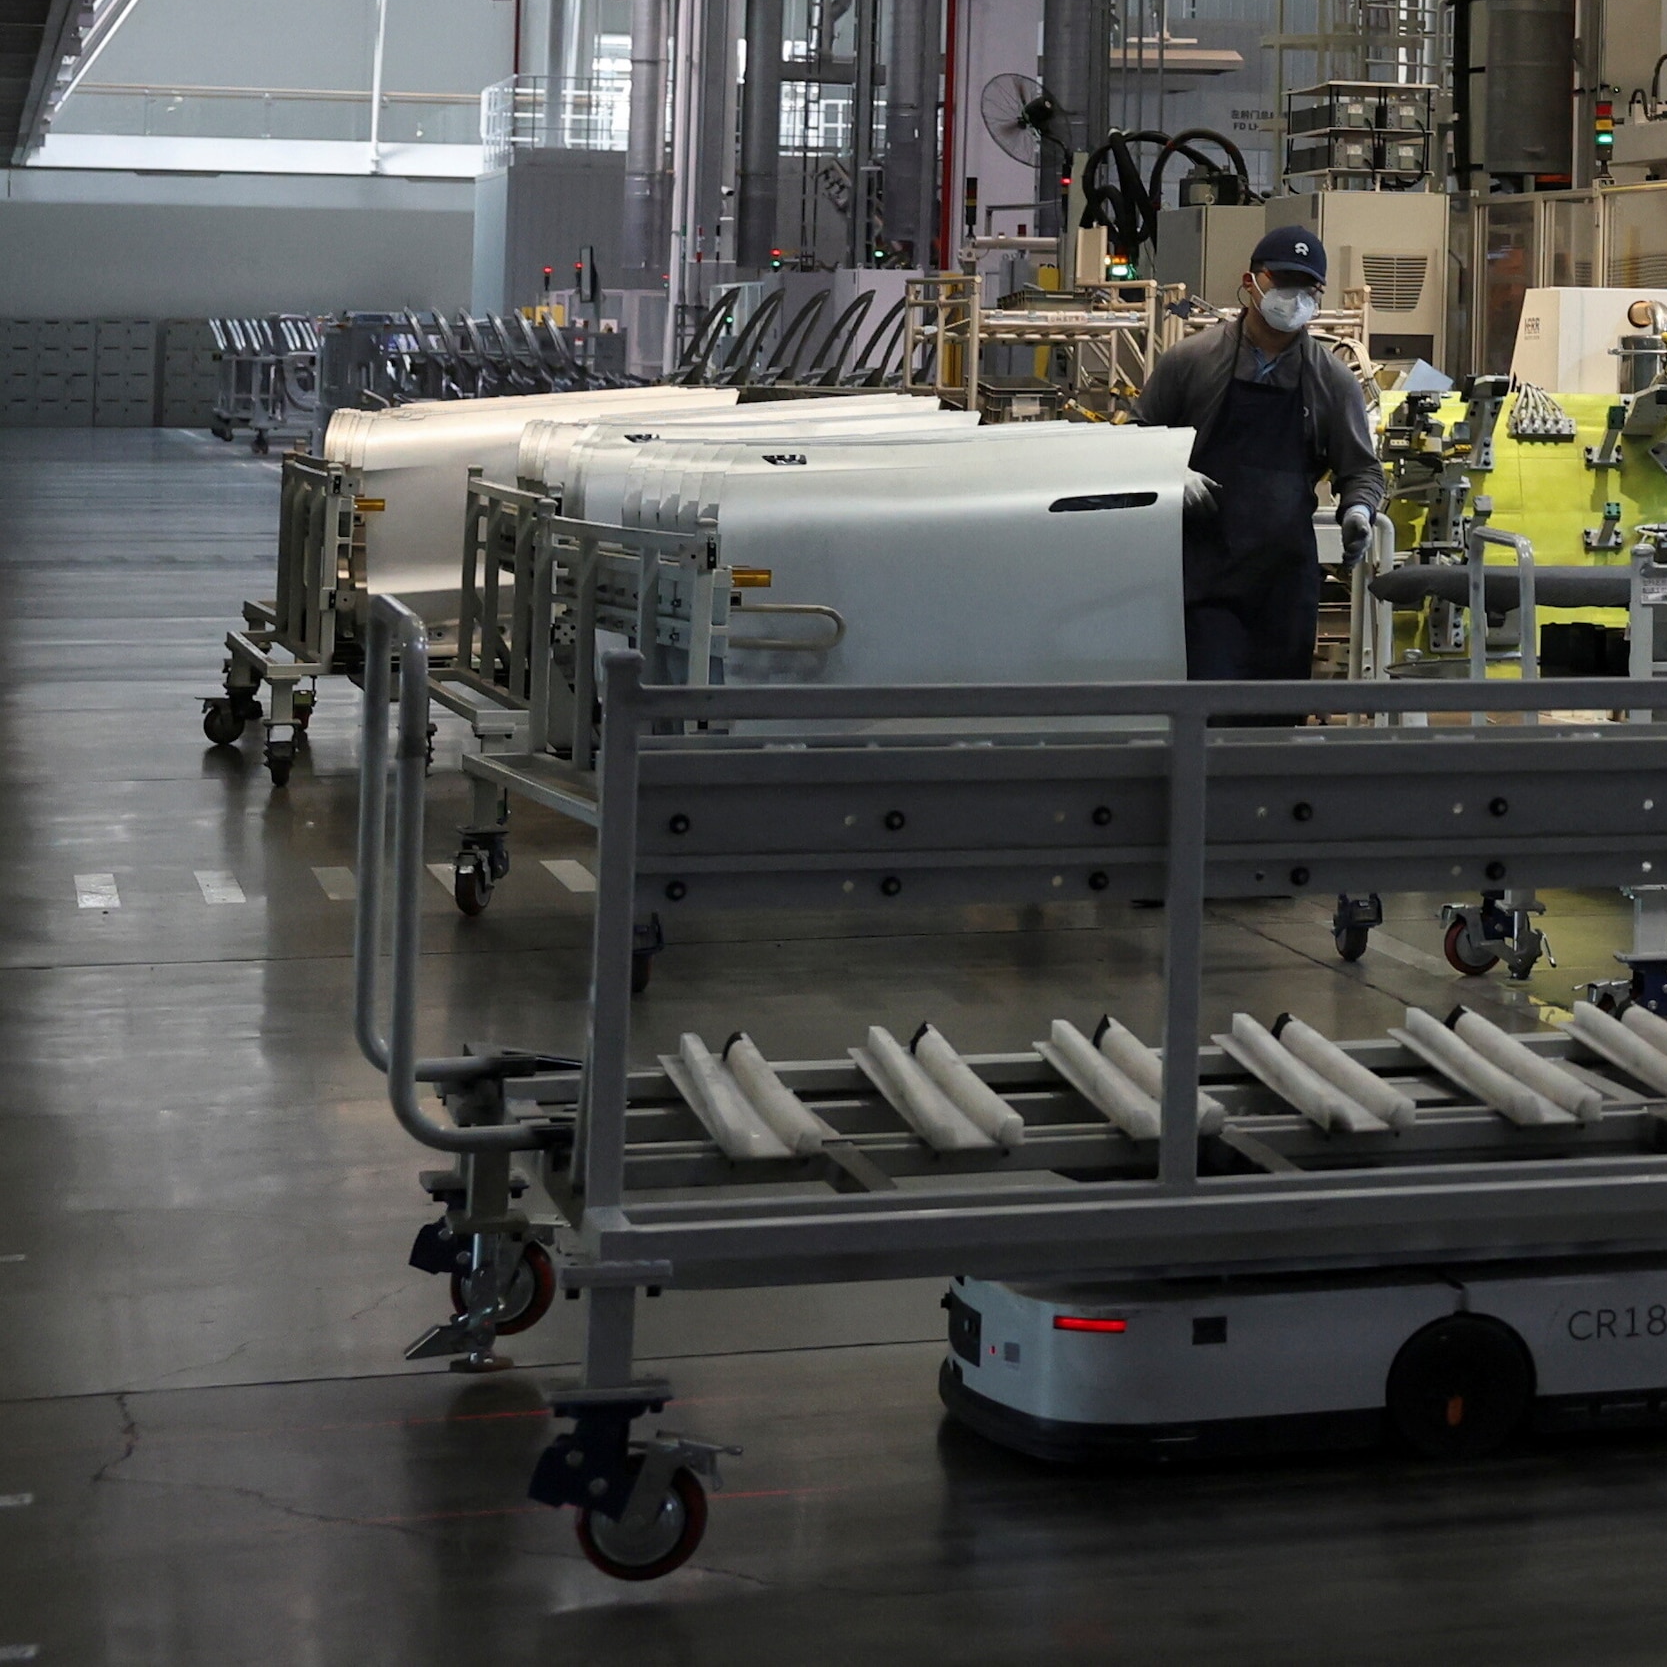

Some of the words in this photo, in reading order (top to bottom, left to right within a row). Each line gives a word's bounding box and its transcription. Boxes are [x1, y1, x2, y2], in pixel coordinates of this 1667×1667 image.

[1231, 109, 1274, 120] 左前门总
[1568, 1304, 1667, 1341] CR18
